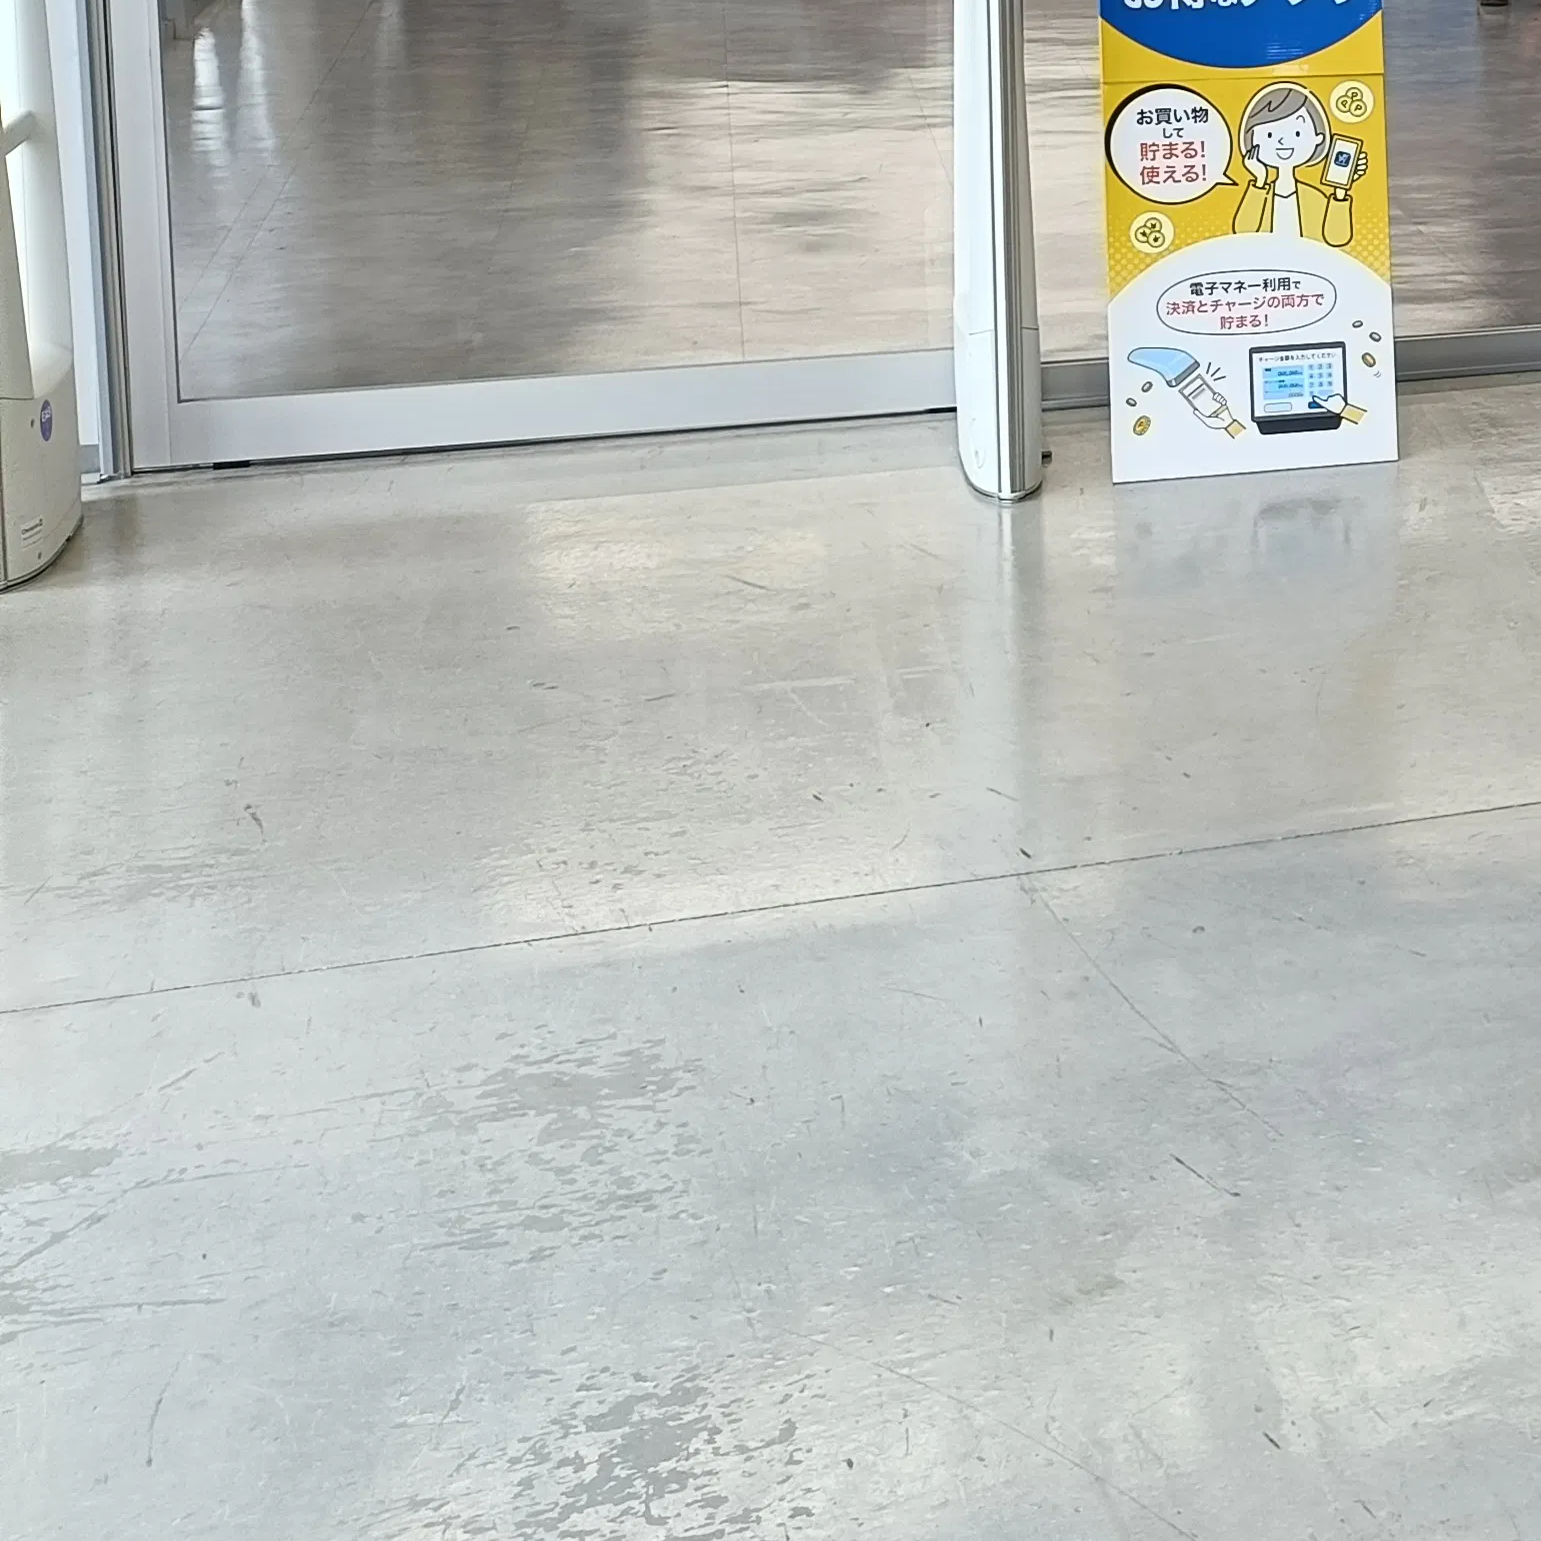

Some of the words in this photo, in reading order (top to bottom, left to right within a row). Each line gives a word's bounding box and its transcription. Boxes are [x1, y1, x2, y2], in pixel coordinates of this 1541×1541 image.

[1136, 106, 1209, 126] お買い物
[1162, 127, 1184, 139] して
[1140, 140, 1206, 162] 貯まる!
[1140, 163, 1207, 185] 使える!
[1189, 277, 1301, 297] 電子マネー利用で
[1166, 293, 1325, 316] 決済とチャージの両方で
[1219, 314, 1269, 330] 貯まる!
